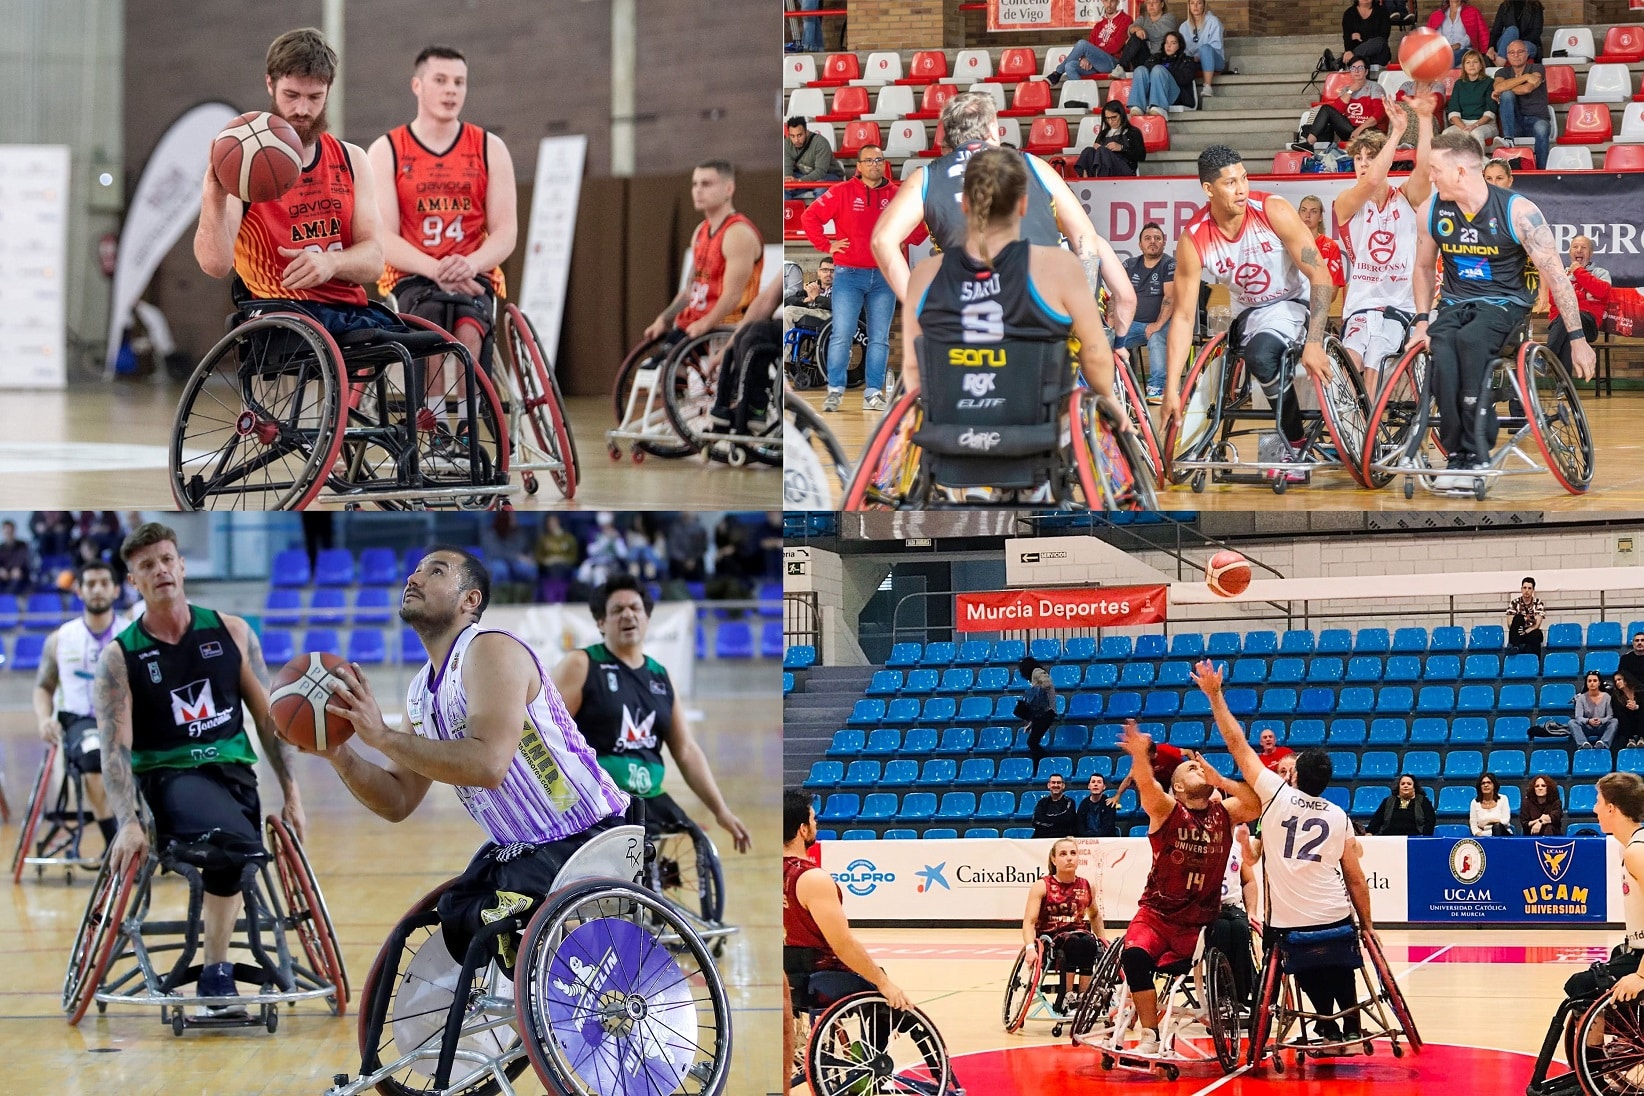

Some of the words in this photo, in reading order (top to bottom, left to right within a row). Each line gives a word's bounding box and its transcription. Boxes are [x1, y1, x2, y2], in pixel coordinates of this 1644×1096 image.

[1004, 9, 1016, 20] de
[1020, 8, 1044, 22] Vigo
[1080, 8, 1093, 18] de
[1366, 208, 1375, 223] 7
[291, 217, 342, 242] AMIA
[422, 214, 465, 247] 94
[1460, 227, 1479, 243] 23
[1442, 243, 1500, 255] ILUNION
[1215, 256, 1236, 274] 24
[966, 600, 1033, 620] Murcia
[1039, 598, 1130, 620] Deportes
[628, 762, 652, 795] 10
[1290, 795, 1330, 812] GOMEZ
[1280, 815, 1330, 863] 12
[830, 872, 896, 883] SOLPRO
[956, 865, 1045, 884] CaixaBank
[1185, 871, 1206, 892] 14
[1444, 889, 1491, 901] UCAM
[1522, 884, 1590, 904] UCAM
[1524, 904, 1588, 915] UNIVERSIDAD
